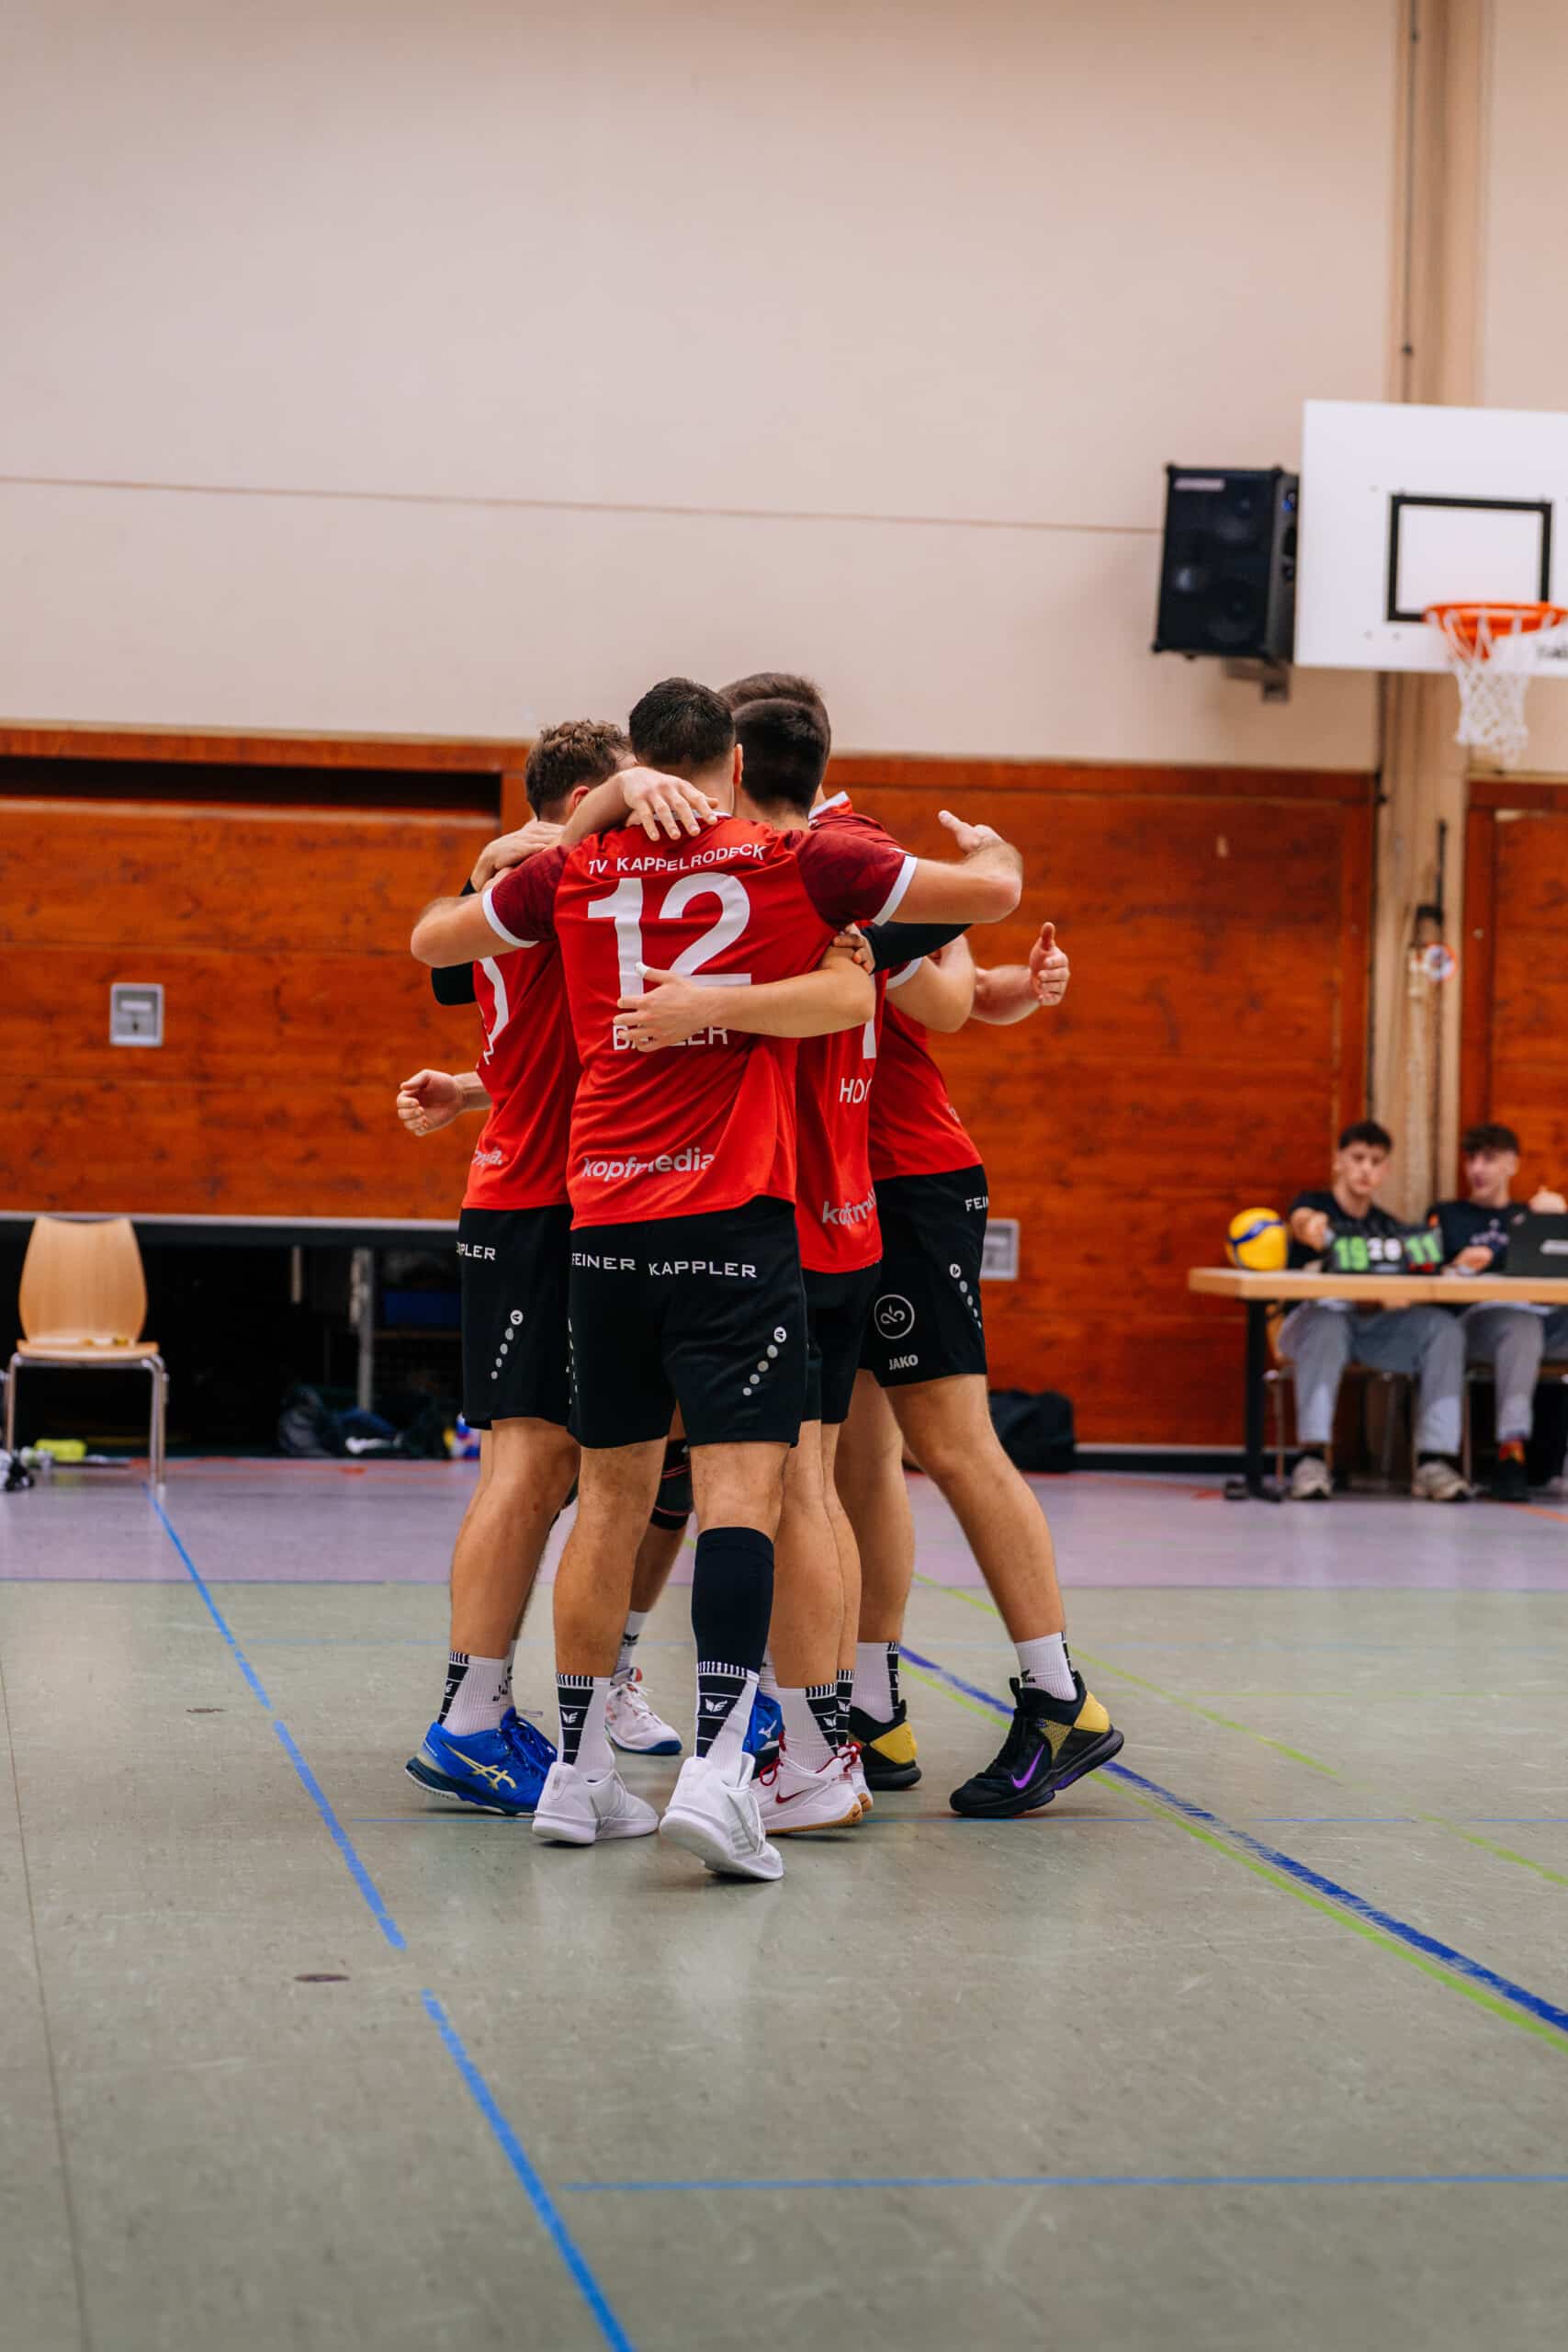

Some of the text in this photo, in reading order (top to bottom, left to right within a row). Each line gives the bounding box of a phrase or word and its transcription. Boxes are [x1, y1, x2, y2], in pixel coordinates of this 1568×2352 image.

[589, 843, 766, 874] TV KAPPELRODECK
[588, 872, 750, 1001] 12
[649, 1261, 757, 1278] KAPPLER
[888, 1354, 919, 1370] JAKO
